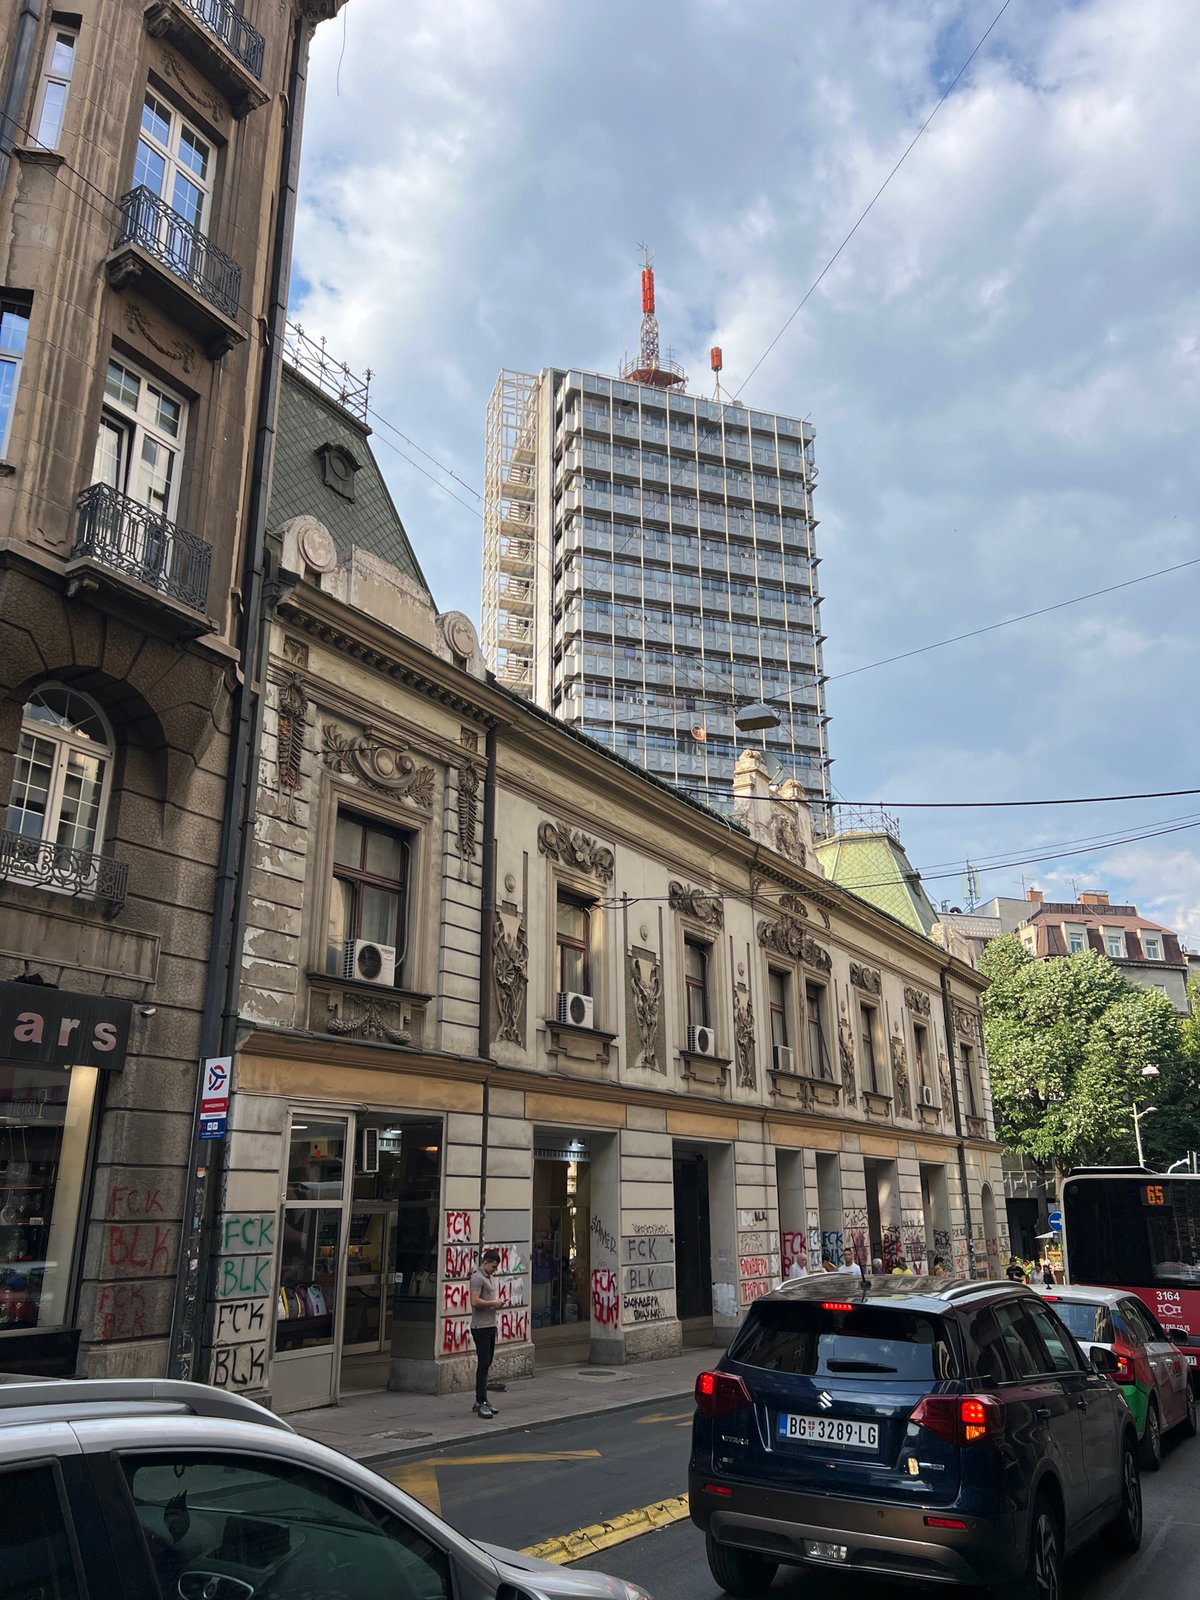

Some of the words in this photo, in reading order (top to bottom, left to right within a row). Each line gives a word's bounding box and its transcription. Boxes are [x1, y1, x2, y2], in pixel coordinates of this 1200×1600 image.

[111, 1186, 164, 1217] FCK
[1147, 1185, 1164, 1205] 65
[225, 1218, 274, 1248] FCK
[446, 1211, 472, 1238] FCK
[109, 1225, 172, 1274] BLK
[629, 1238, 657, 1260] FCK
[782, 1231, 807, 1256] FCK
[822, 1231, 843, 1248] FCK
[220, 1256, 270, 1297] BLK
[445, 1247, 473, 1280] BLK!
[593, 1268, 616, 1296] FCK
[629, 1268, 655, 1289] BLK
[444, 1284, 470, 1312] FCK
[593, 1291, 619, 1329] BLK!
[1156, 1291, 1180, 1301] 3164
[217, 1302, 264, 1338] FCK
[501, 1312, 528, 1341] BLK!
[213, 1347, 264, 1386] BLK
[790, 1417, 806, 1436] BG
